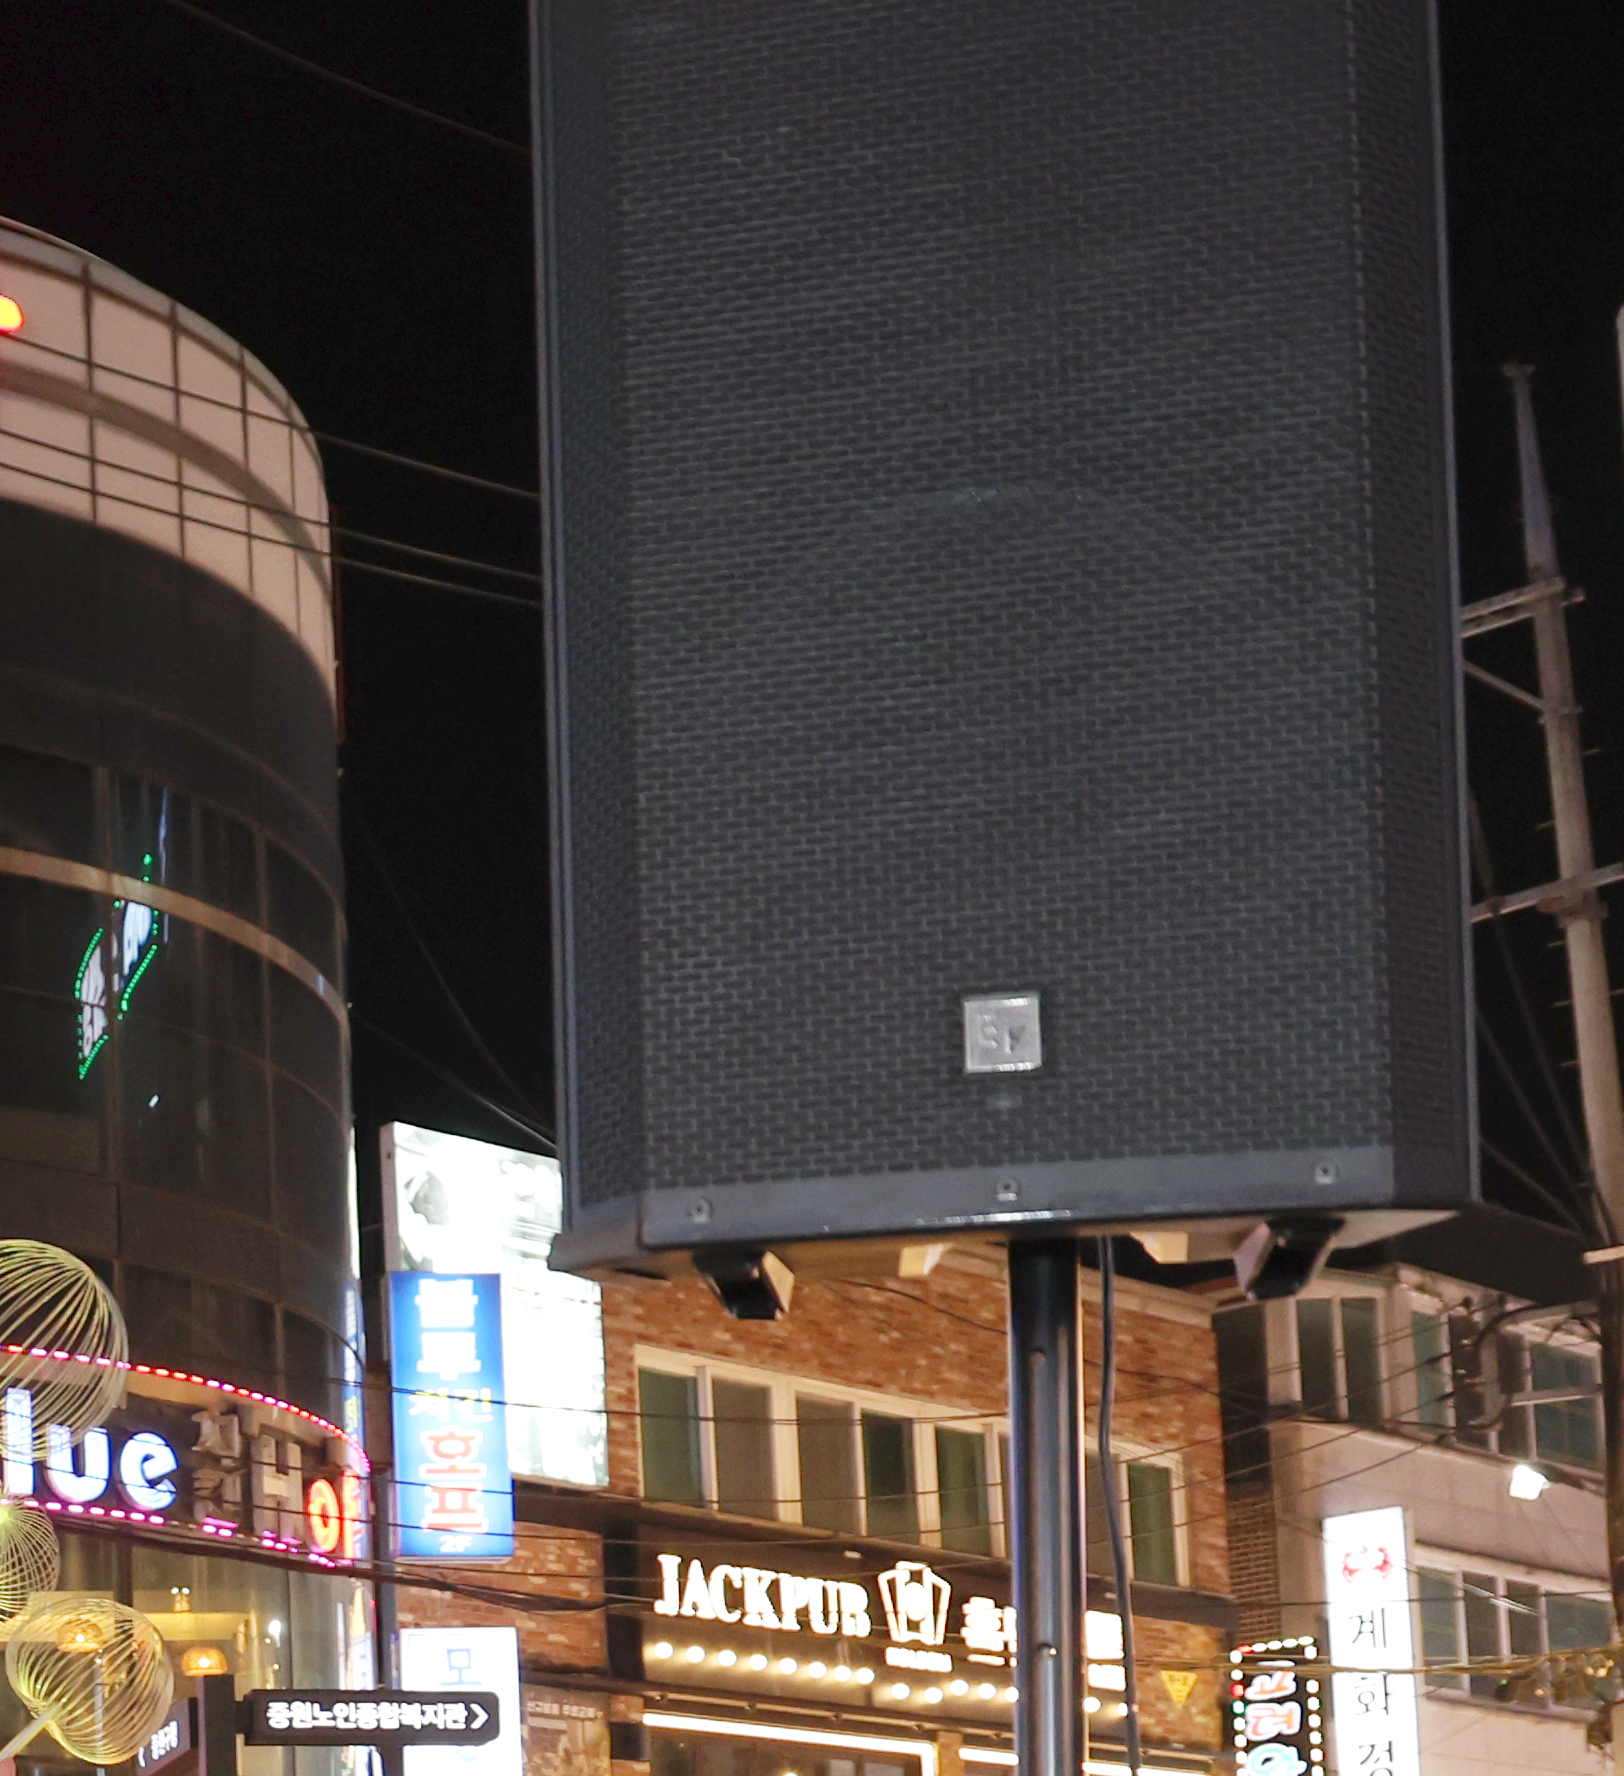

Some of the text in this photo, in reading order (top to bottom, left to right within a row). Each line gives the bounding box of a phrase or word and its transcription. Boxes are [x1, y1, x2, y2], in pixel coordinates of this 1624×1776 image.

[418, 1429, 490, 1534] 호프
[652, 1553, 873, 1638] JACKPUB
[266, 1701, 468, 1730] 중원노인종합복지관
